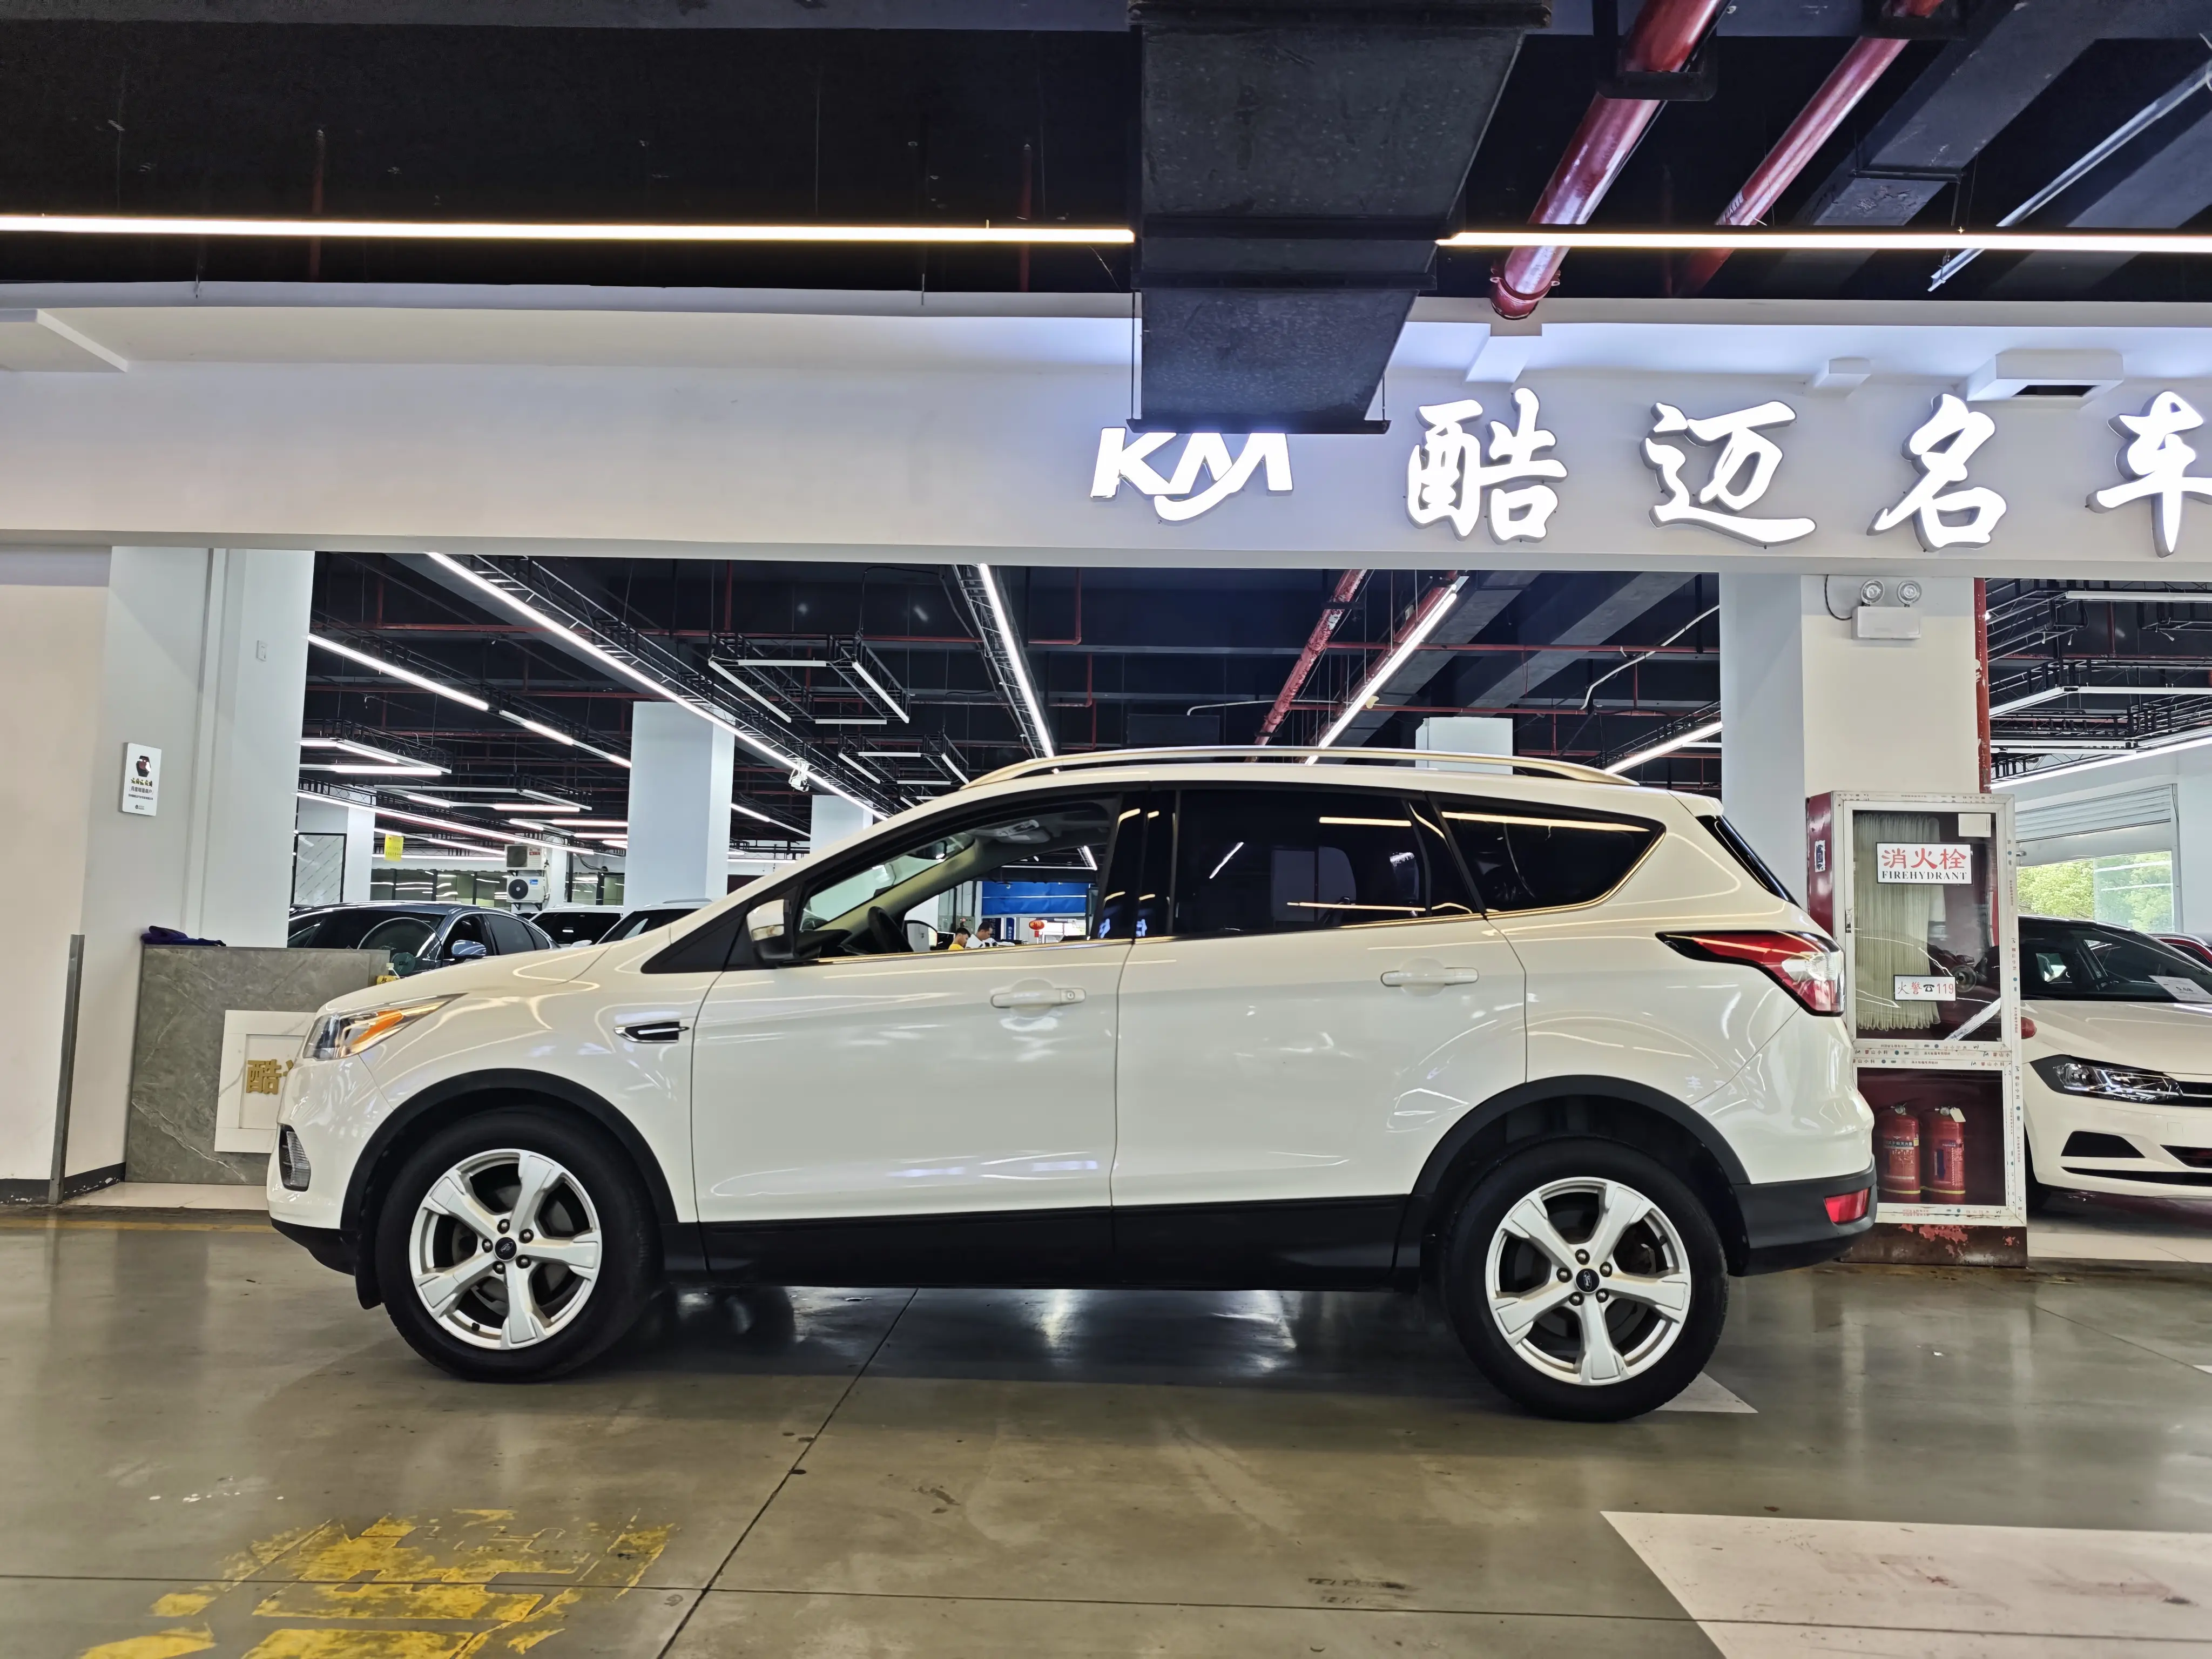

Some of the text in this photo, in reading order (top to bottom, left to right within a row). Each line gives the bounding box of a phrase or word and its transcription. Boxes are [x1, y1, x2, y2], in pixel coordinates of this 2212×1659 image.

[1406, 387, 2212, 556] 酷迈名车
[1881, 848, 1967, 870] 消火栓
[1882, 871, 1967, 880] FIREHYDRANT
[1897, 981, 1954, 995] 火警 119
[246, 1058, 294, 1095] 酷
